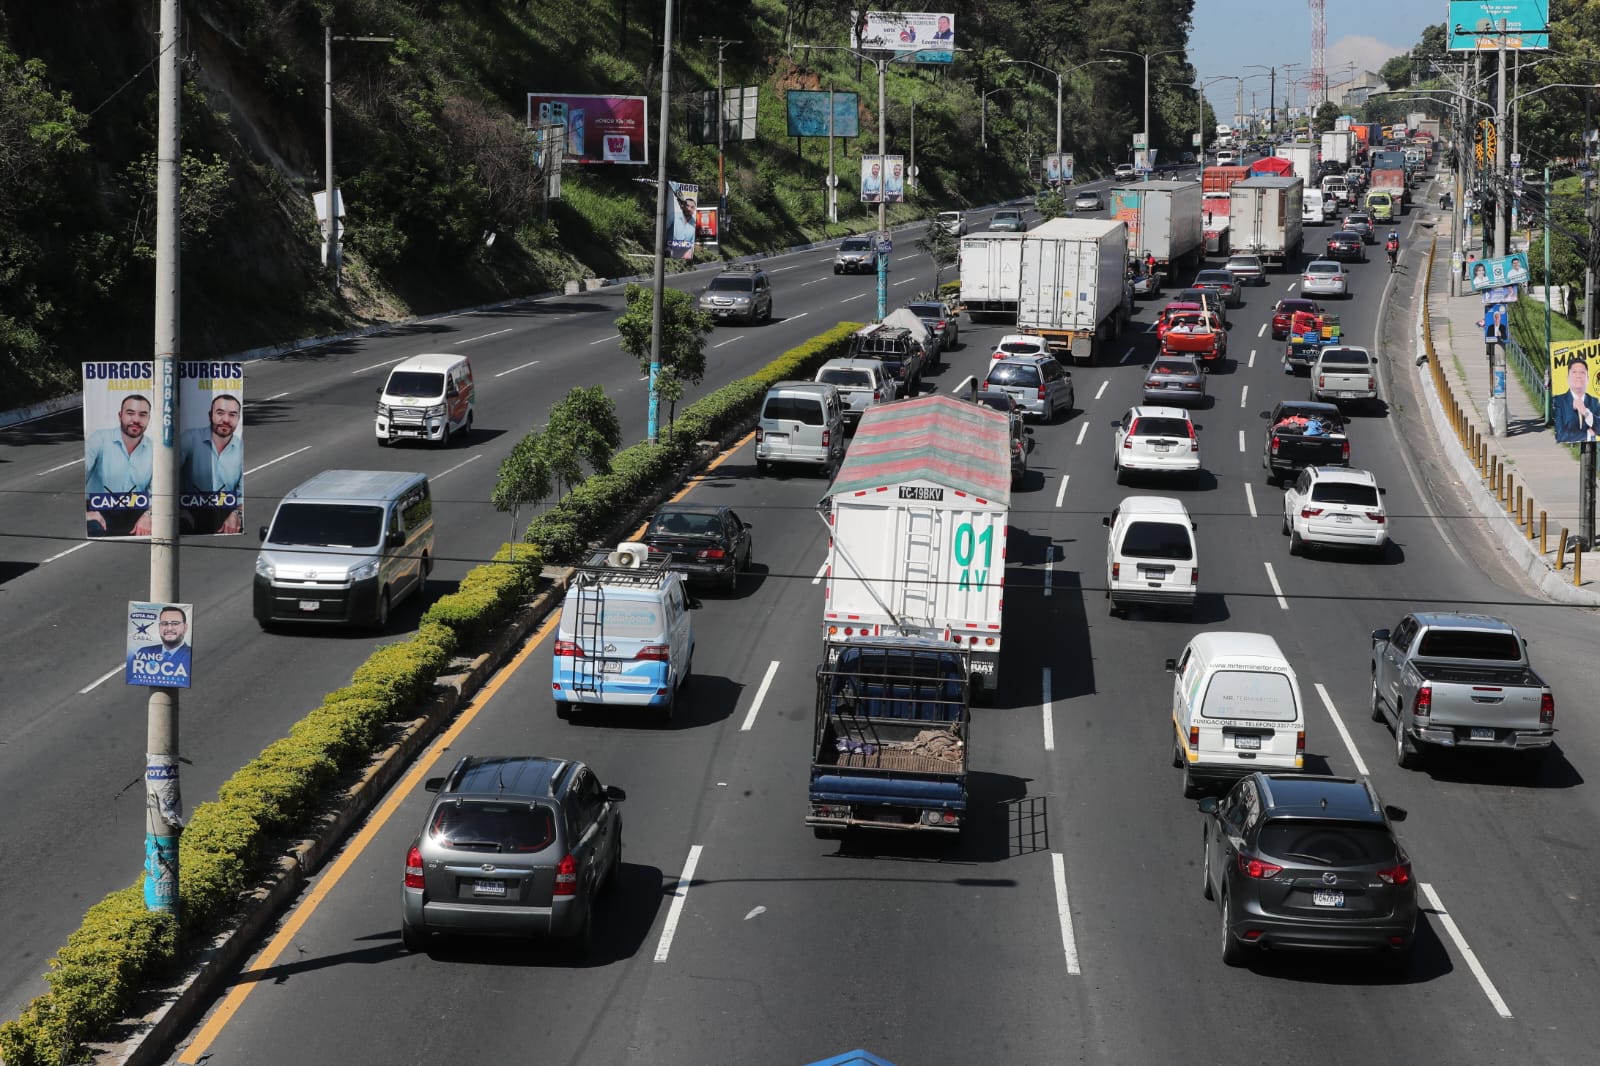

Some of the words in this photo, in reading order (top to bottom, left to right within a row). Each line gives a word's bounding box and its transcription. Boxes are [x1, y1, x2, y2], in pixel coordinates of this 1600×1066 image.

[1553, 344, 1600, 370] MANU
[86, 362, 152, 380] BURGOS
[178, 362, 242, 379] BURGOS
[163, 361, 173, 440] 508461
[91, 493, 148, 508] CAMBIO
[900, 486, 941, 501] TC-19BKV
[954, 523, 993, 568] 01
[134, 652, 163, 661] YANG
[132, 660, 188, 678] ROCA
